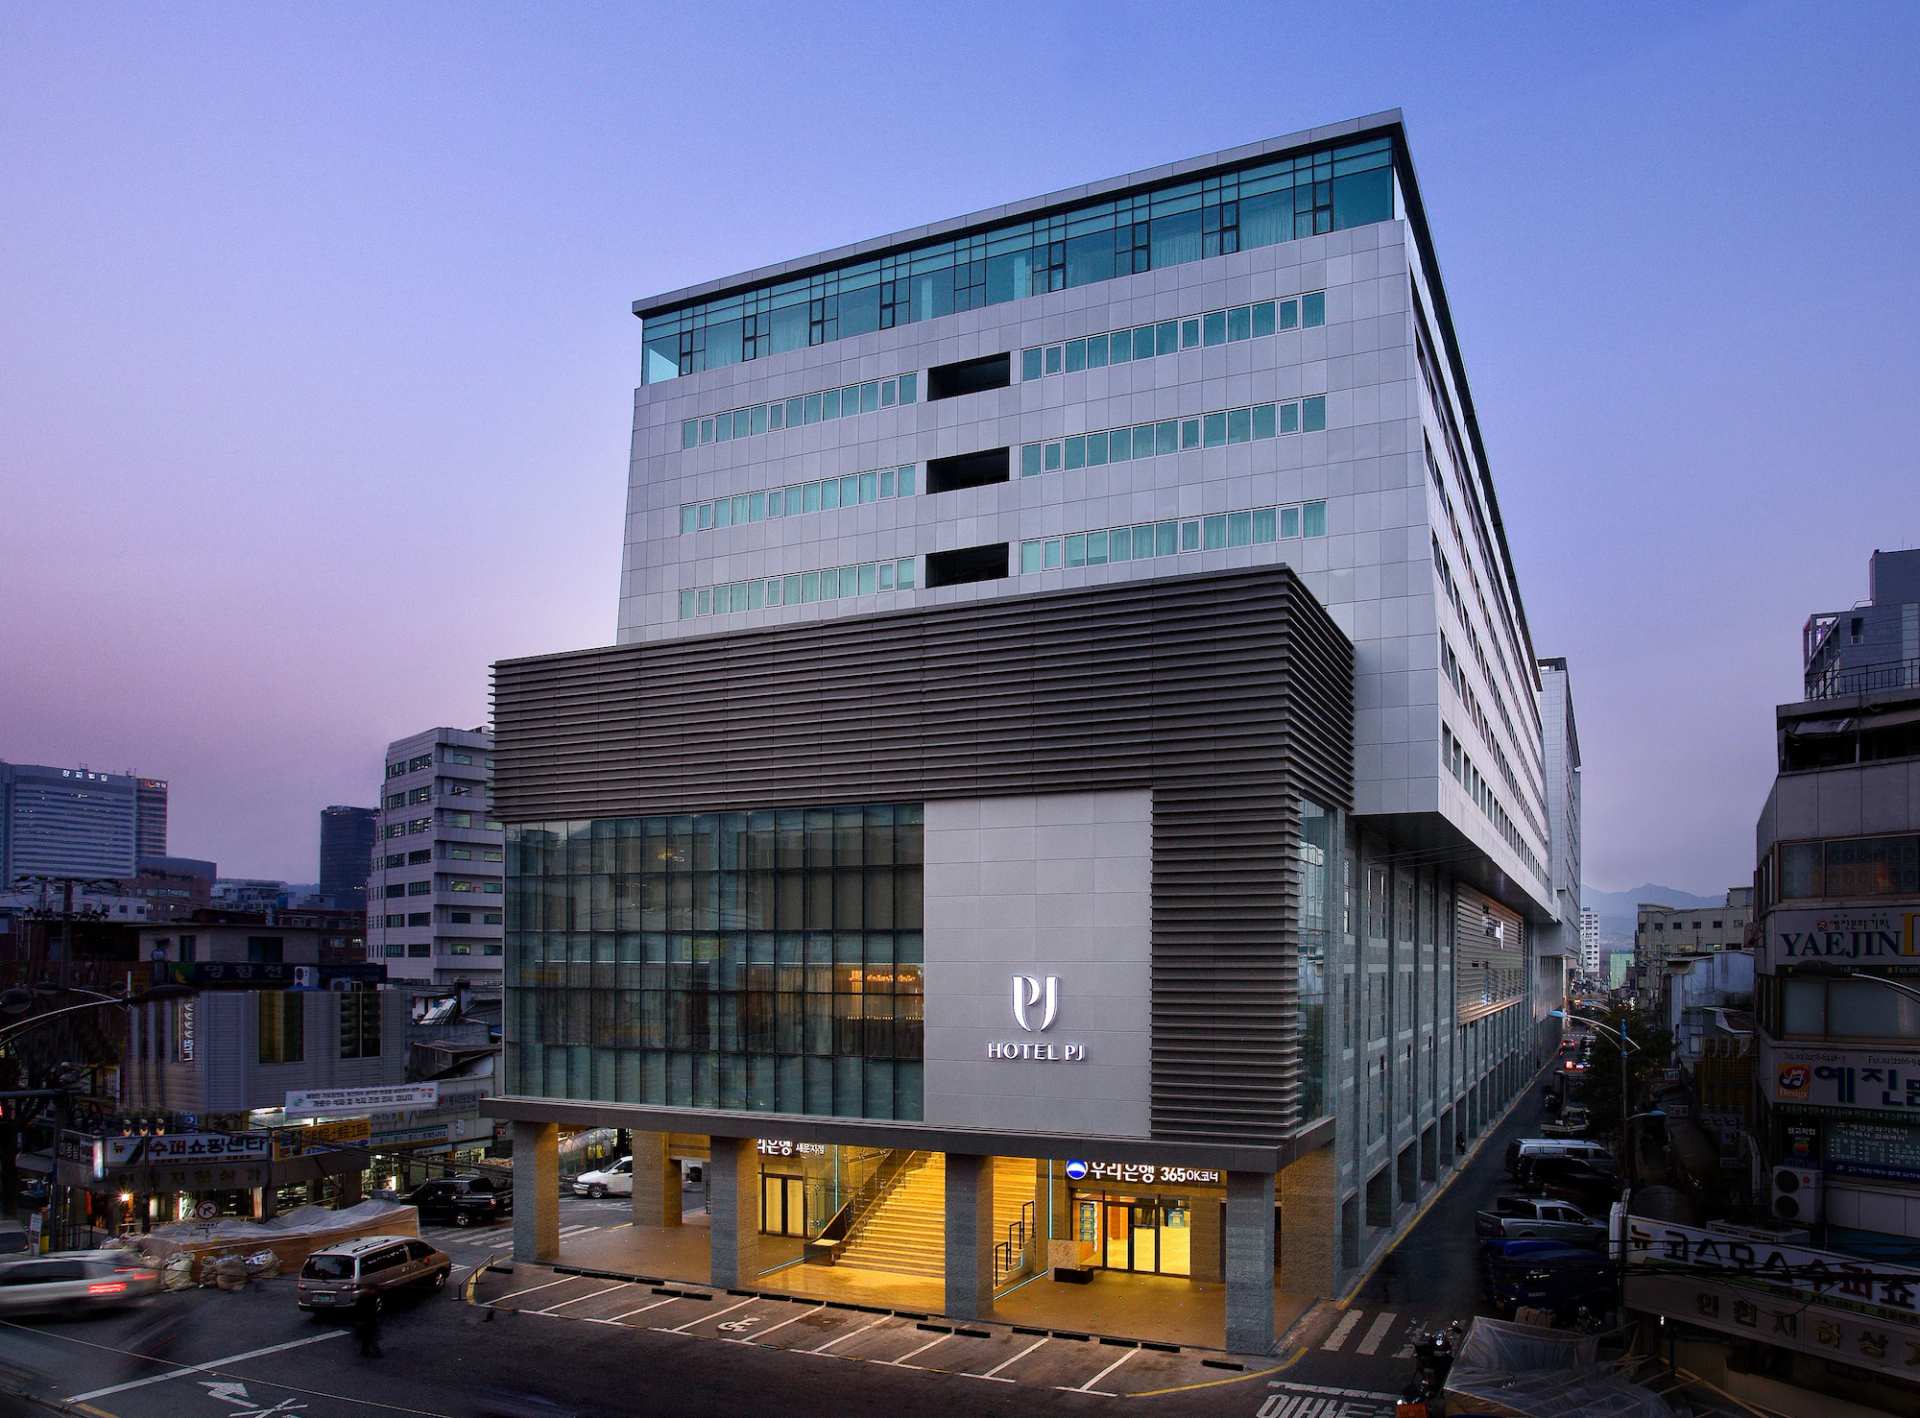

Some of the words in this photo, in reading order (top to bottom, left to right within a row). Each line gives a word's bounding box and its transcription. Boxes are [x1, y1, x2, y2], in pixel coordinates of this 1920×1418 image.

[1780, 931, 1902, 958] YAEJIN
[987, 1042, 1060, 1060] HOTEL
[1064, 1043, 1085, 1061] PJ
[1090, 1162, 1155, 1183] 우리은행
